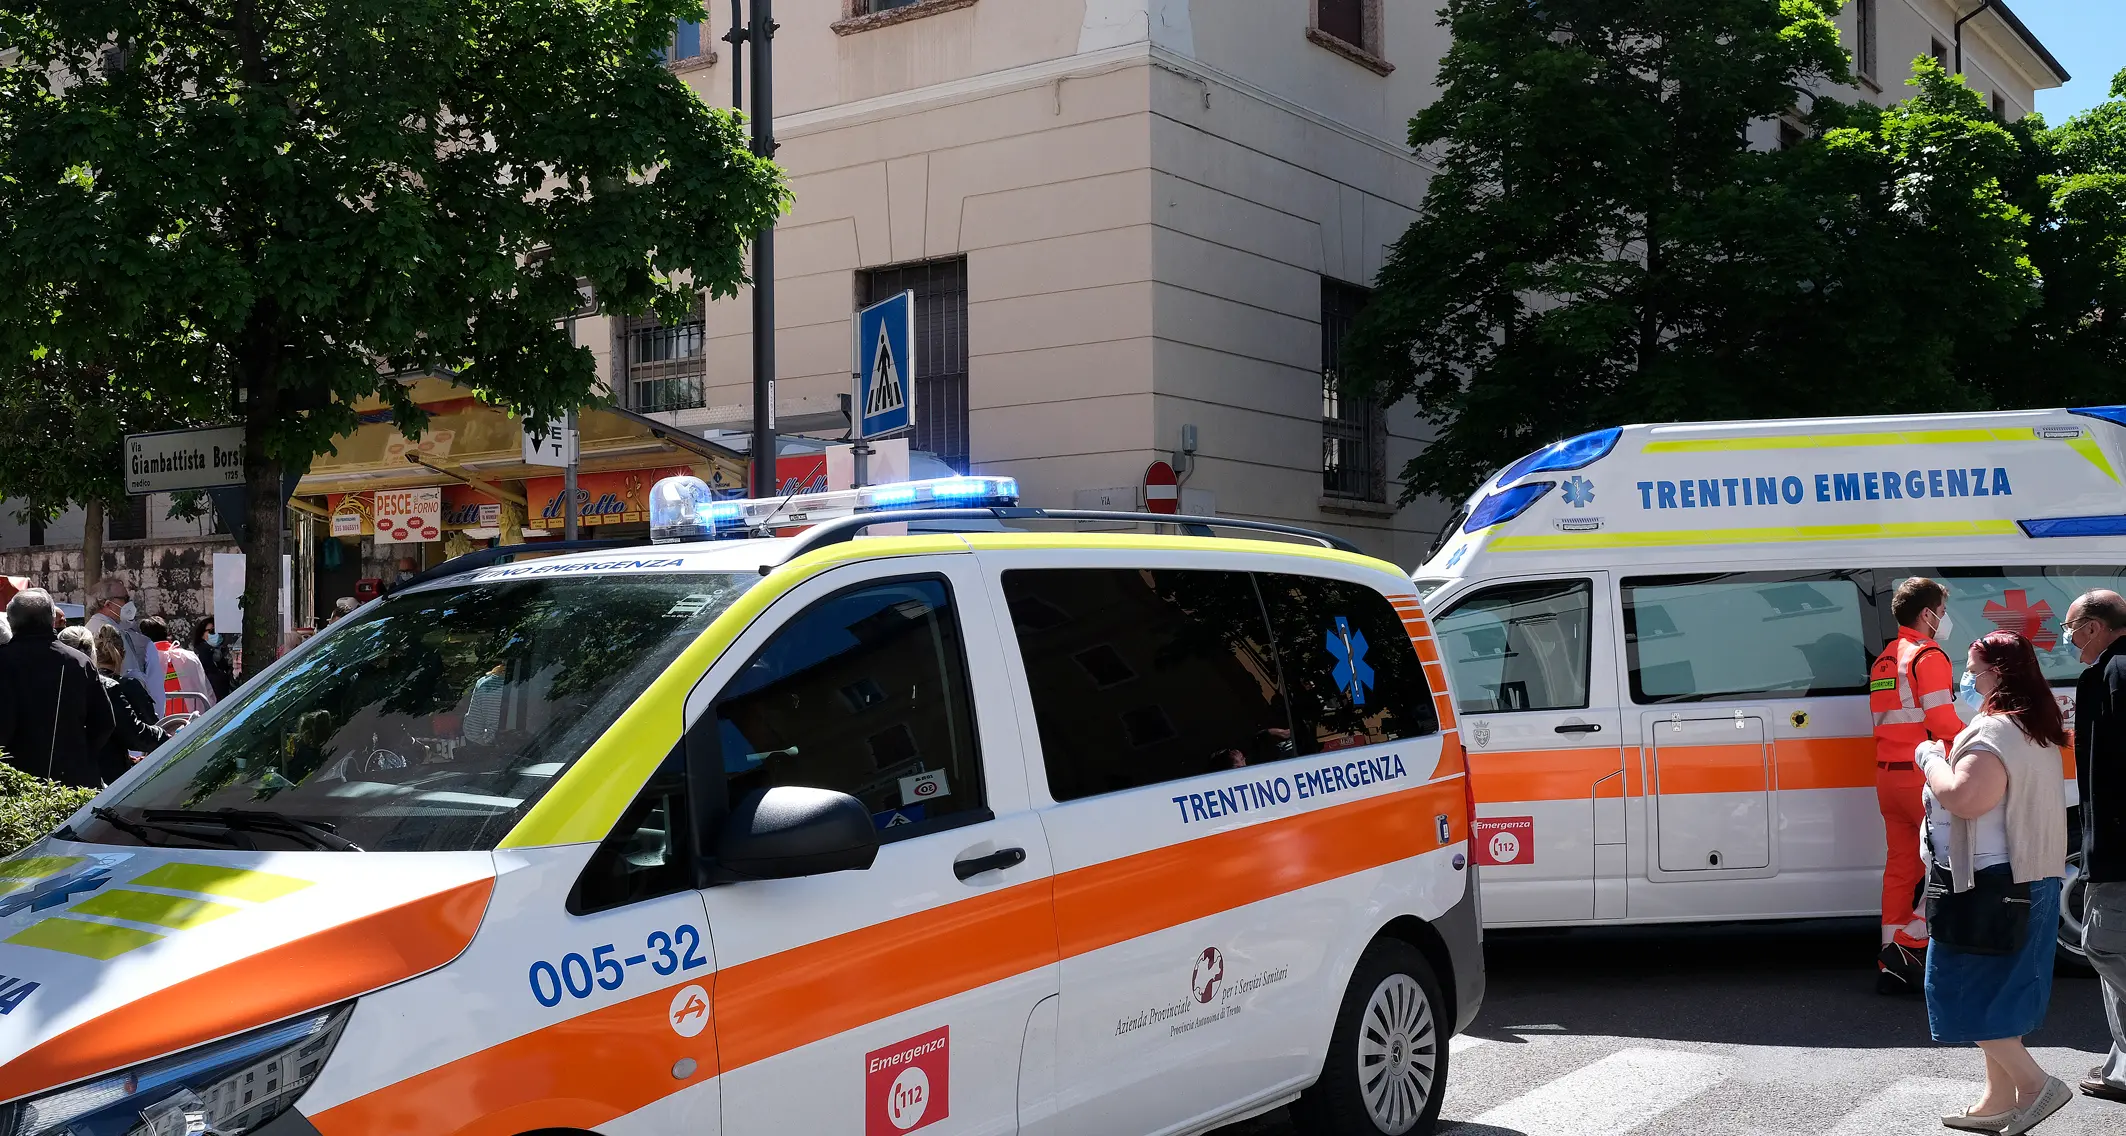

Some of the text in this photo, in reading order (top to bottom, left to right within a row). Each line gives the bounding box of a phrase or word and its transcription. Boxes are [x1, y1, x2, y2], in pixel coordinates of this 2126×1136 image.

[130, 442, 142, 453] Via
[131, 444, 245, 475] Giambattista Borsi
[131, 480, 151, 488] medico
[224, 471, 239, 480] 1725
[1637, 467, 2013, 509] TRENTINO EMERGENZA
[377, 493, 412, 516] PESCE
[413, 502, 439, 514] FORNO
[535, 558, 685, 575] EMERGENZA
[1173, 753, 1407, 824] TRENTINO EMERGENZA
[1476, 821, 1531, 830] Emergenza
[1498, 843, 1514, 852] 112
[528, 924, 707, 1008] 005-32
[1115, 1011, 1148, 1036] Azienda
[1149, 996, 1192, 1025] Provinciale
[1222, 985, 1234, 1004] per
[1239, 972, 1262, 994] Servizi
[1263, 964, 1289, 988] Sanitari
[1170, 1021, 1195, 1037] Provincia
[1194, 1012, 1220, 1030] Autonoma
[1226, 1004, 1242, 1018] Trento
[869, 1037, 945, 1074] Emergenza
[900, 1085, 922, 1108] 112
